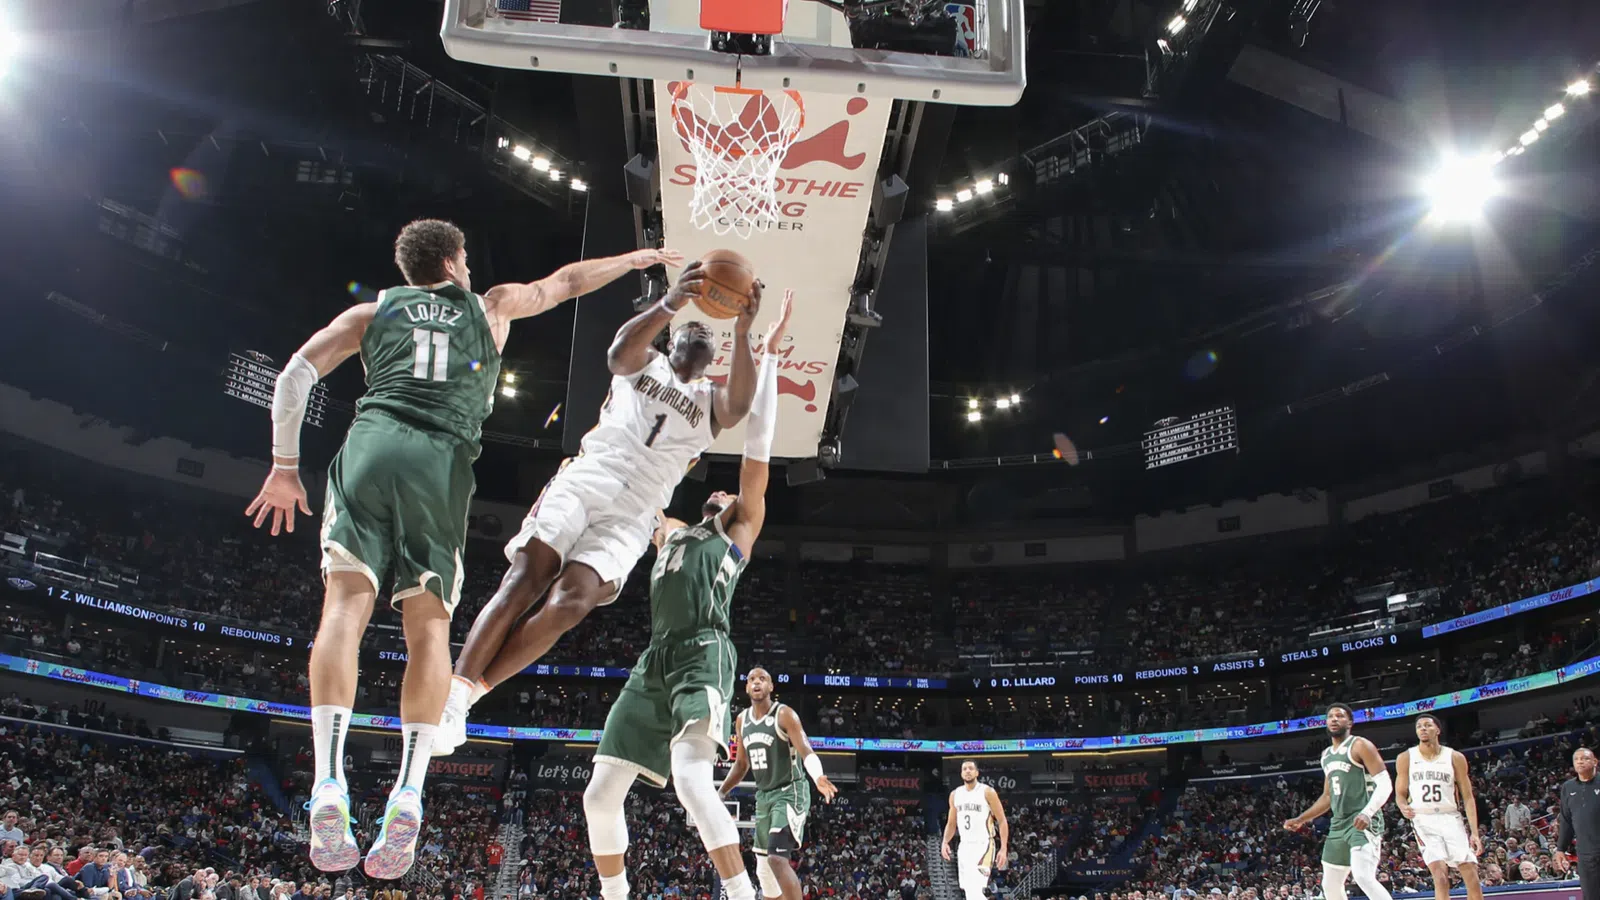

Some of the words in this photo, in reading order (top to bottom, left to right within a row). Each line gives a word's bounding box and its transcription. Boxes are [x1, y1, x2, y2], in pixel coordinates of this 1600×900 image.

[405, 303, 463, 326] LOPEZ
[413, 328, 450, 382] 11
[634, 374, 665, 399] NEW
[660, 386, 704, 429] ORLEANS
[645, 413, 667, 448] 1
[47, 587, 53, 596] 1
[75, 592, 151, 620] WILLIAMSON
[1519, 600, 1539, 609] MADE
[1549, 588, 1574, 602] Chill
[150, 611, 188, 628] POINTS
[192, 621, 206, 632] 10
[220, 625, 281, 644] REBOUNDS
[286, 637, 293, 646] 3
[1342, 636, 1384, 652] BLOCKS
[1390, 635, 1397, 645] 0
[379, 651, 409, 662] STEAL
[1281, 648, 1318, 663] STEALS
[1322, 647, 1329, 656] 0
[1135, 666, 1188, 680] REBOUNDS
[1192, 666, 1199, 675] 3
[1213, 659, 1255, 672] ASSISTS
[1259, 659, 1265, 668] 5
[778, 674, 790, 683] 50
[824, 675, 851, 687] BUCKS
[991, 679, 997, 687] 0
[1002, 679, 1012, 687] D.
[1014, 677, 1056, 687] LILLARD
[1074, 675, 1109, 684] POINTS
[1112, 674, 1124, 683] 10
[257, 701, 283, 714] Coors
[1307, 717, 1327, 728] Coo
[749, 748, 768, 771] 22
[537, 764, 570, 779] Let's
[571, 765, 591, 780] Go
[1084, 772, 1149, 788] SEATGEEK
[1412, 771, 1424, 781] NEW
[1425, 770, 1451, 784] ORLEANS
[864, 776, 920, 790] SEATGEEK
[980, 776, 995, 788] t's
[998, 776, 1016, 789] Go
[1331, 776, 1342, 796] 5
[1422, 784, 1442, 803] 25
[964, 815, 971, 830] 3
